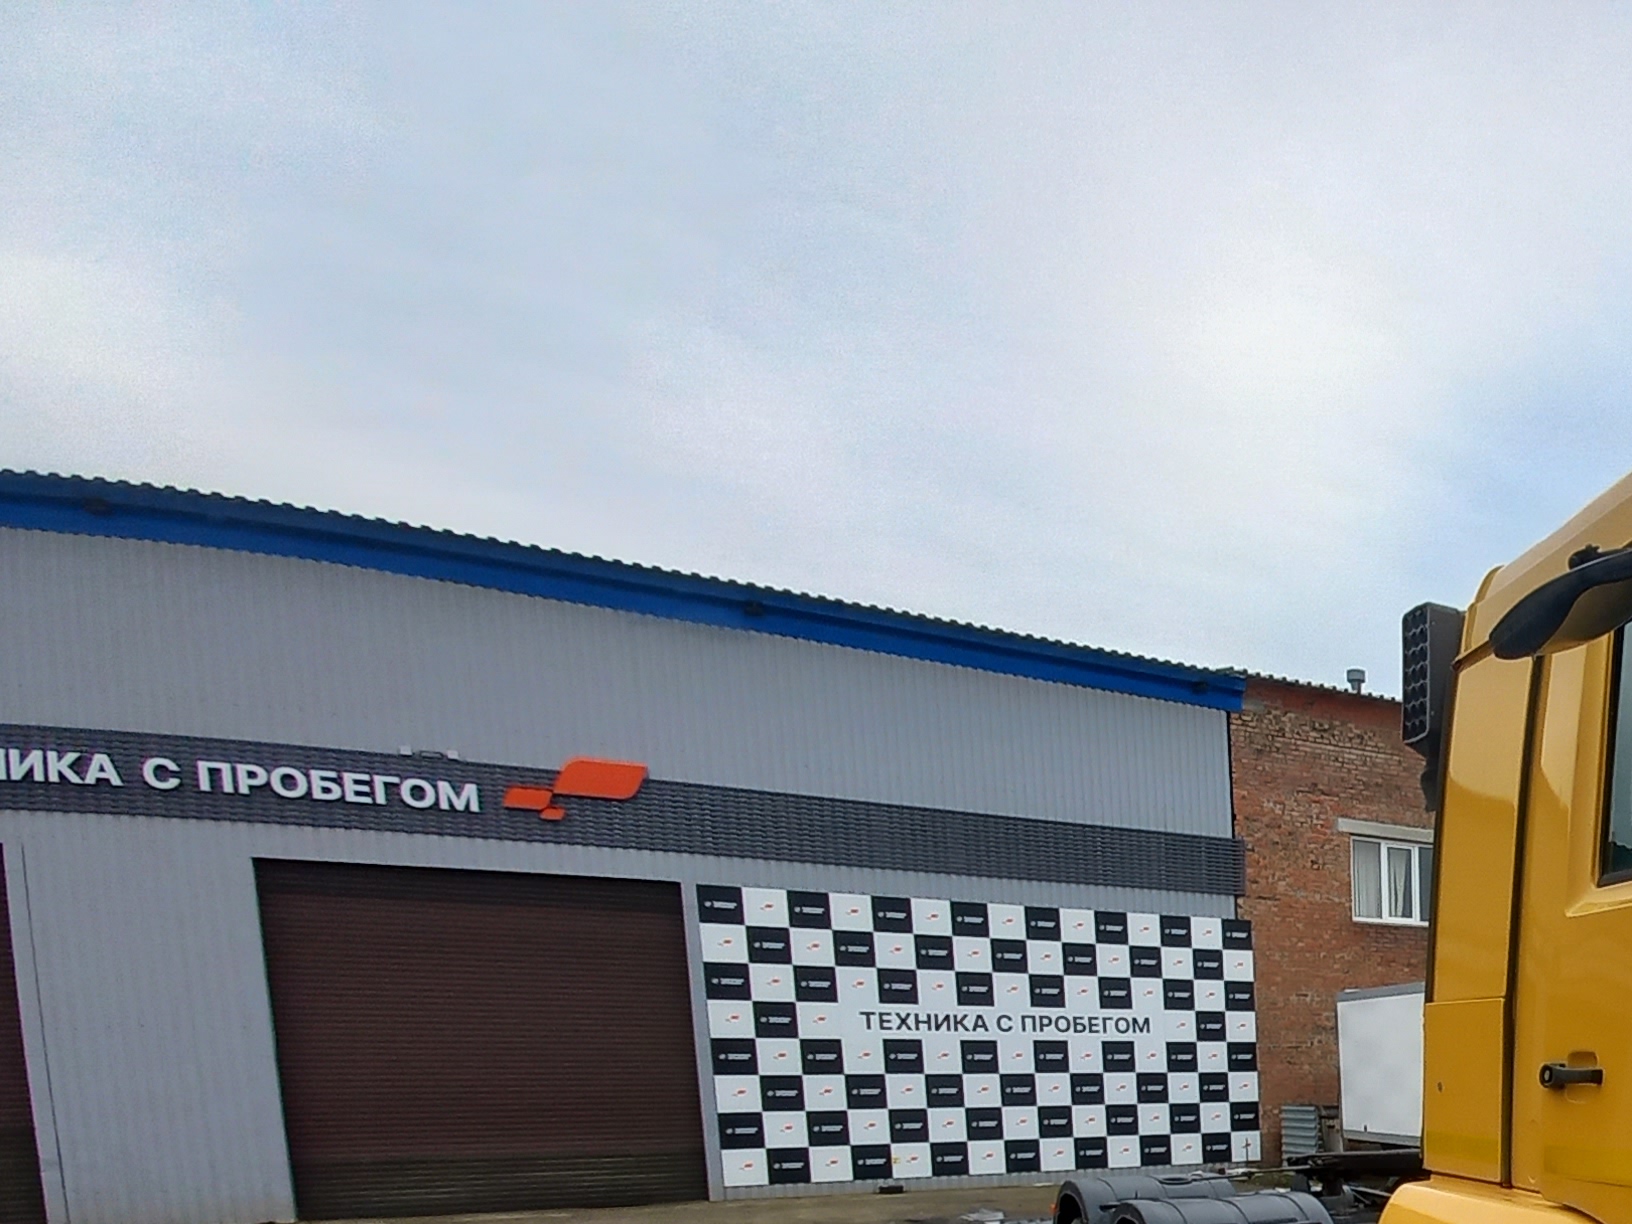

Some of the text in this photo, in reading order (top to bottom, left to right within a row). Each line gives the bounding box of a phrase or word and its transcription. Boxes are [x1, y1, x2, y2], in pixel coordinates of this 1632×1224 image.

[0, 748, 480, 813] ИКА С ПРОБЕГОМ
[859, 1011, 1150, 1034] ТЕХНИКА С ПРОБЕГОМ
